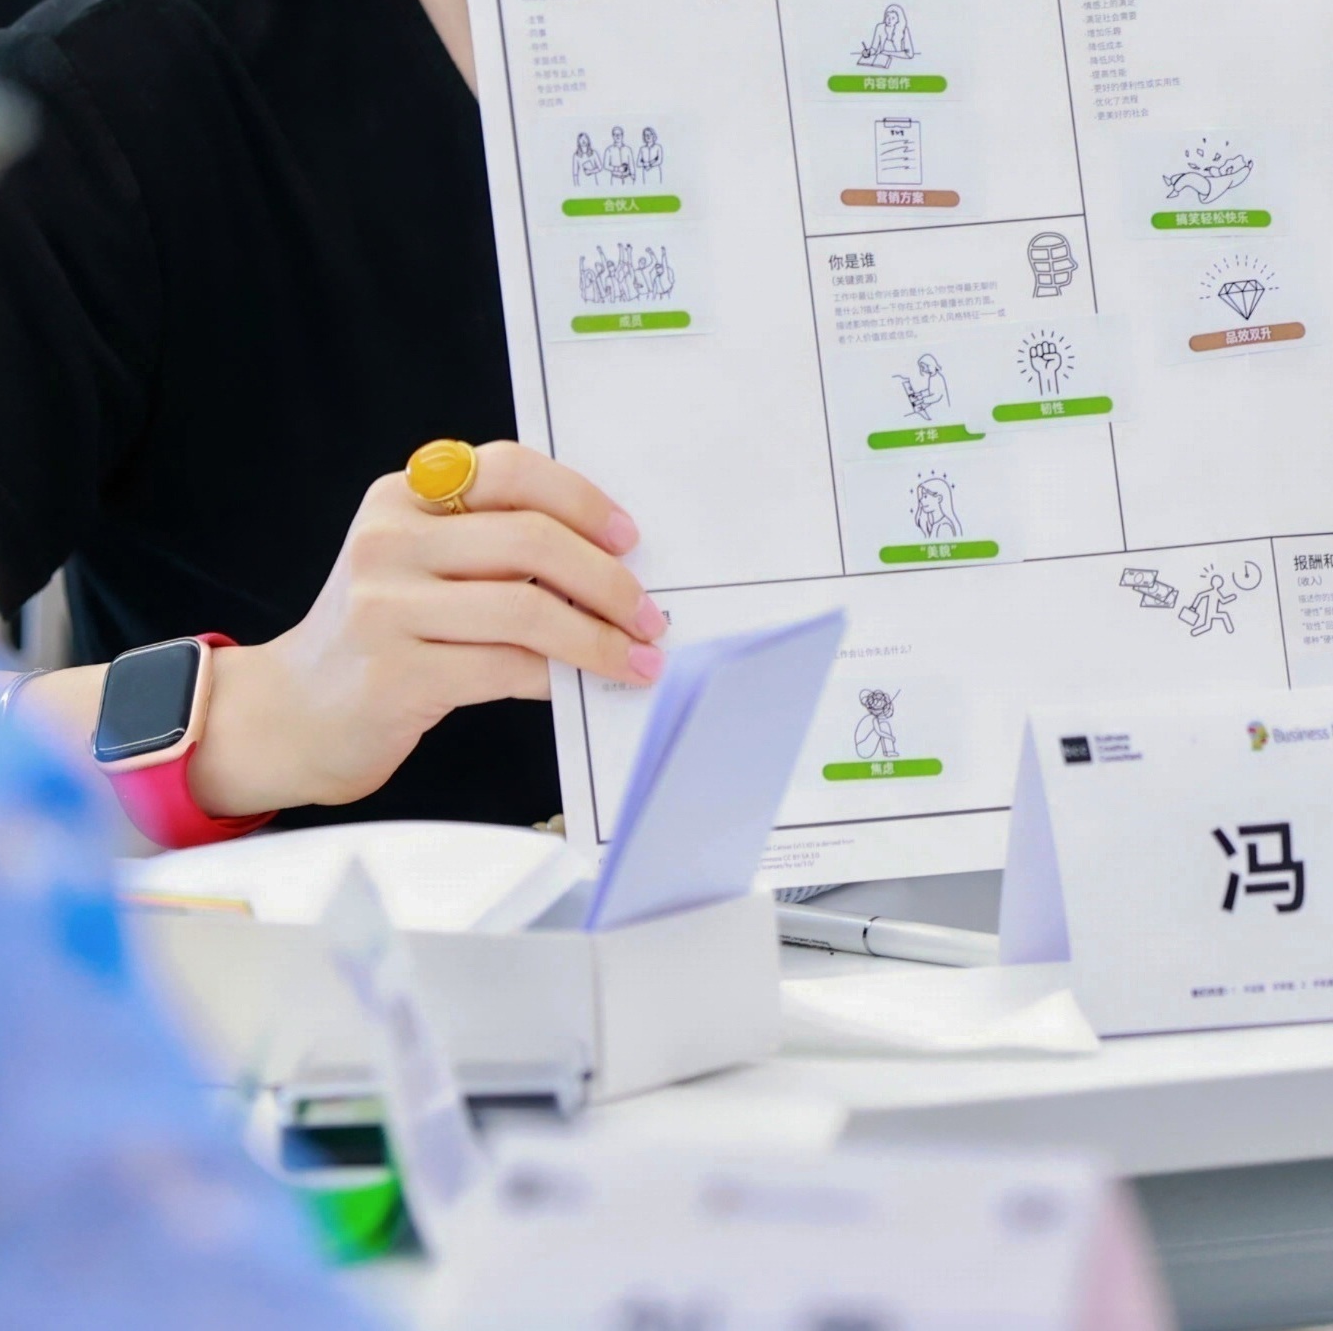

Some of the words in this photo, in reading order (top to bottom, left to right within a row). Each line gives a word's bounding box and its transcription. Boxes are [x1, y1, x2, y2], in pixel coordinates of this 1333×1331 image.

[863, 76, 911, 91] 内容创作
[603, 198, 640, 213] 合伙人
[875, 191, 925, 205] 营销方案
[1175, 210, 1249, 226] 搞笑轻松快乐
[827, 252, 875, 271] 你是谁
[1225, 326, 1272, 345] 品效双升
[914, 428, 939, 443] 才华
[1297, 575, 1323, 588] （收入）
[1272, 728, 1329, 744] Business
[870, 762, 895, 777] 焦虑
[1211, 821, 1305, 914] 冯
